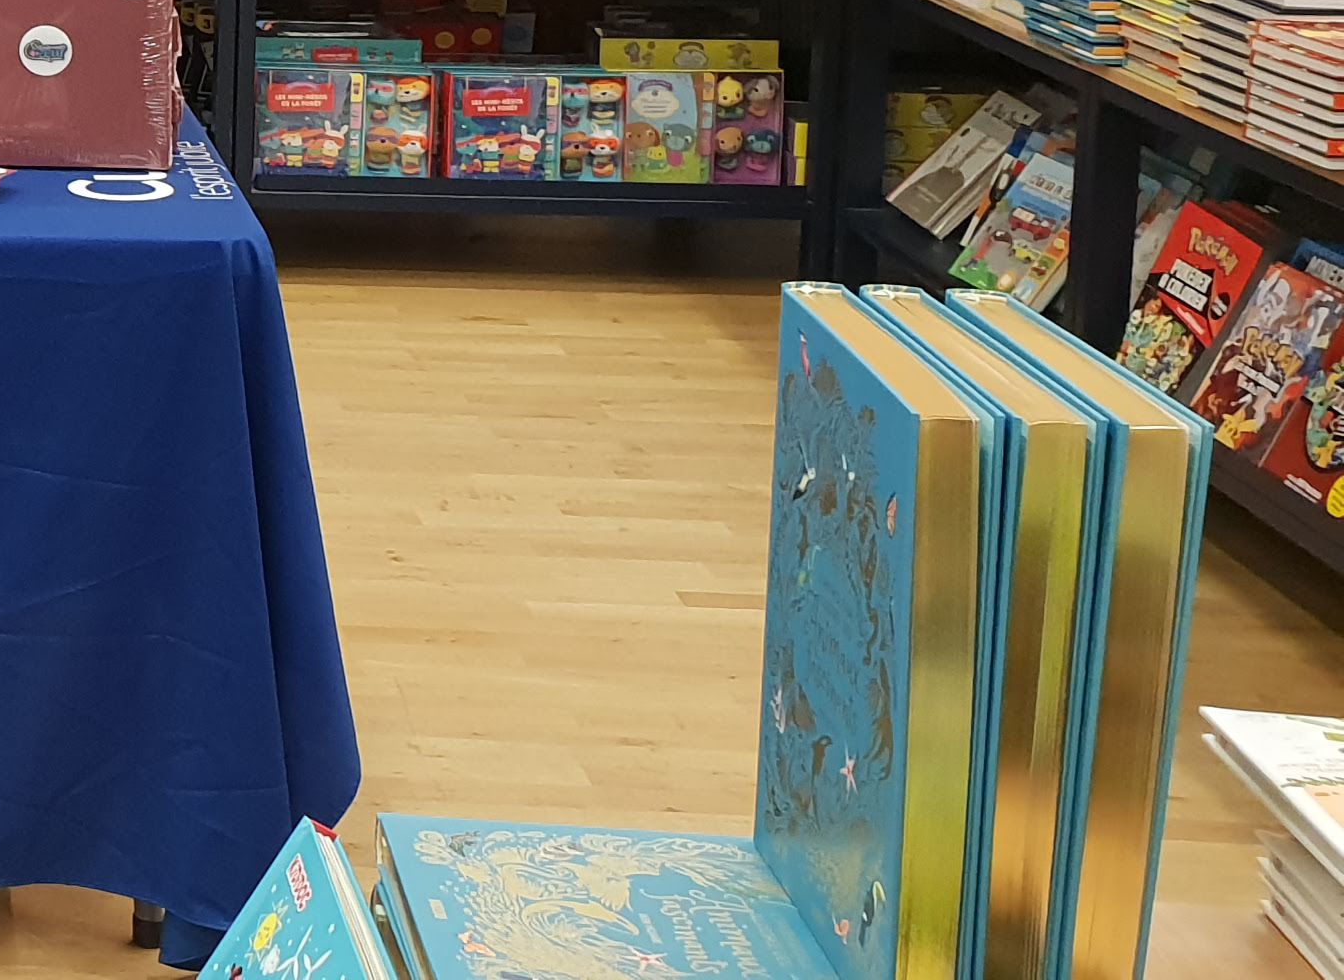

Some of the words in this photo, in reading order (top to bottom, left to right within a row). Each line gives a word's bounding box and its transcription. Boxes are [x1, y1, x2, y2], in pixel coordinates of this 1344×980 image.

[172, 141, 226, 171] jubile
[178, 167, 236, 200] l'esprit
[1187, 227, 1239, 276] Pokémon
